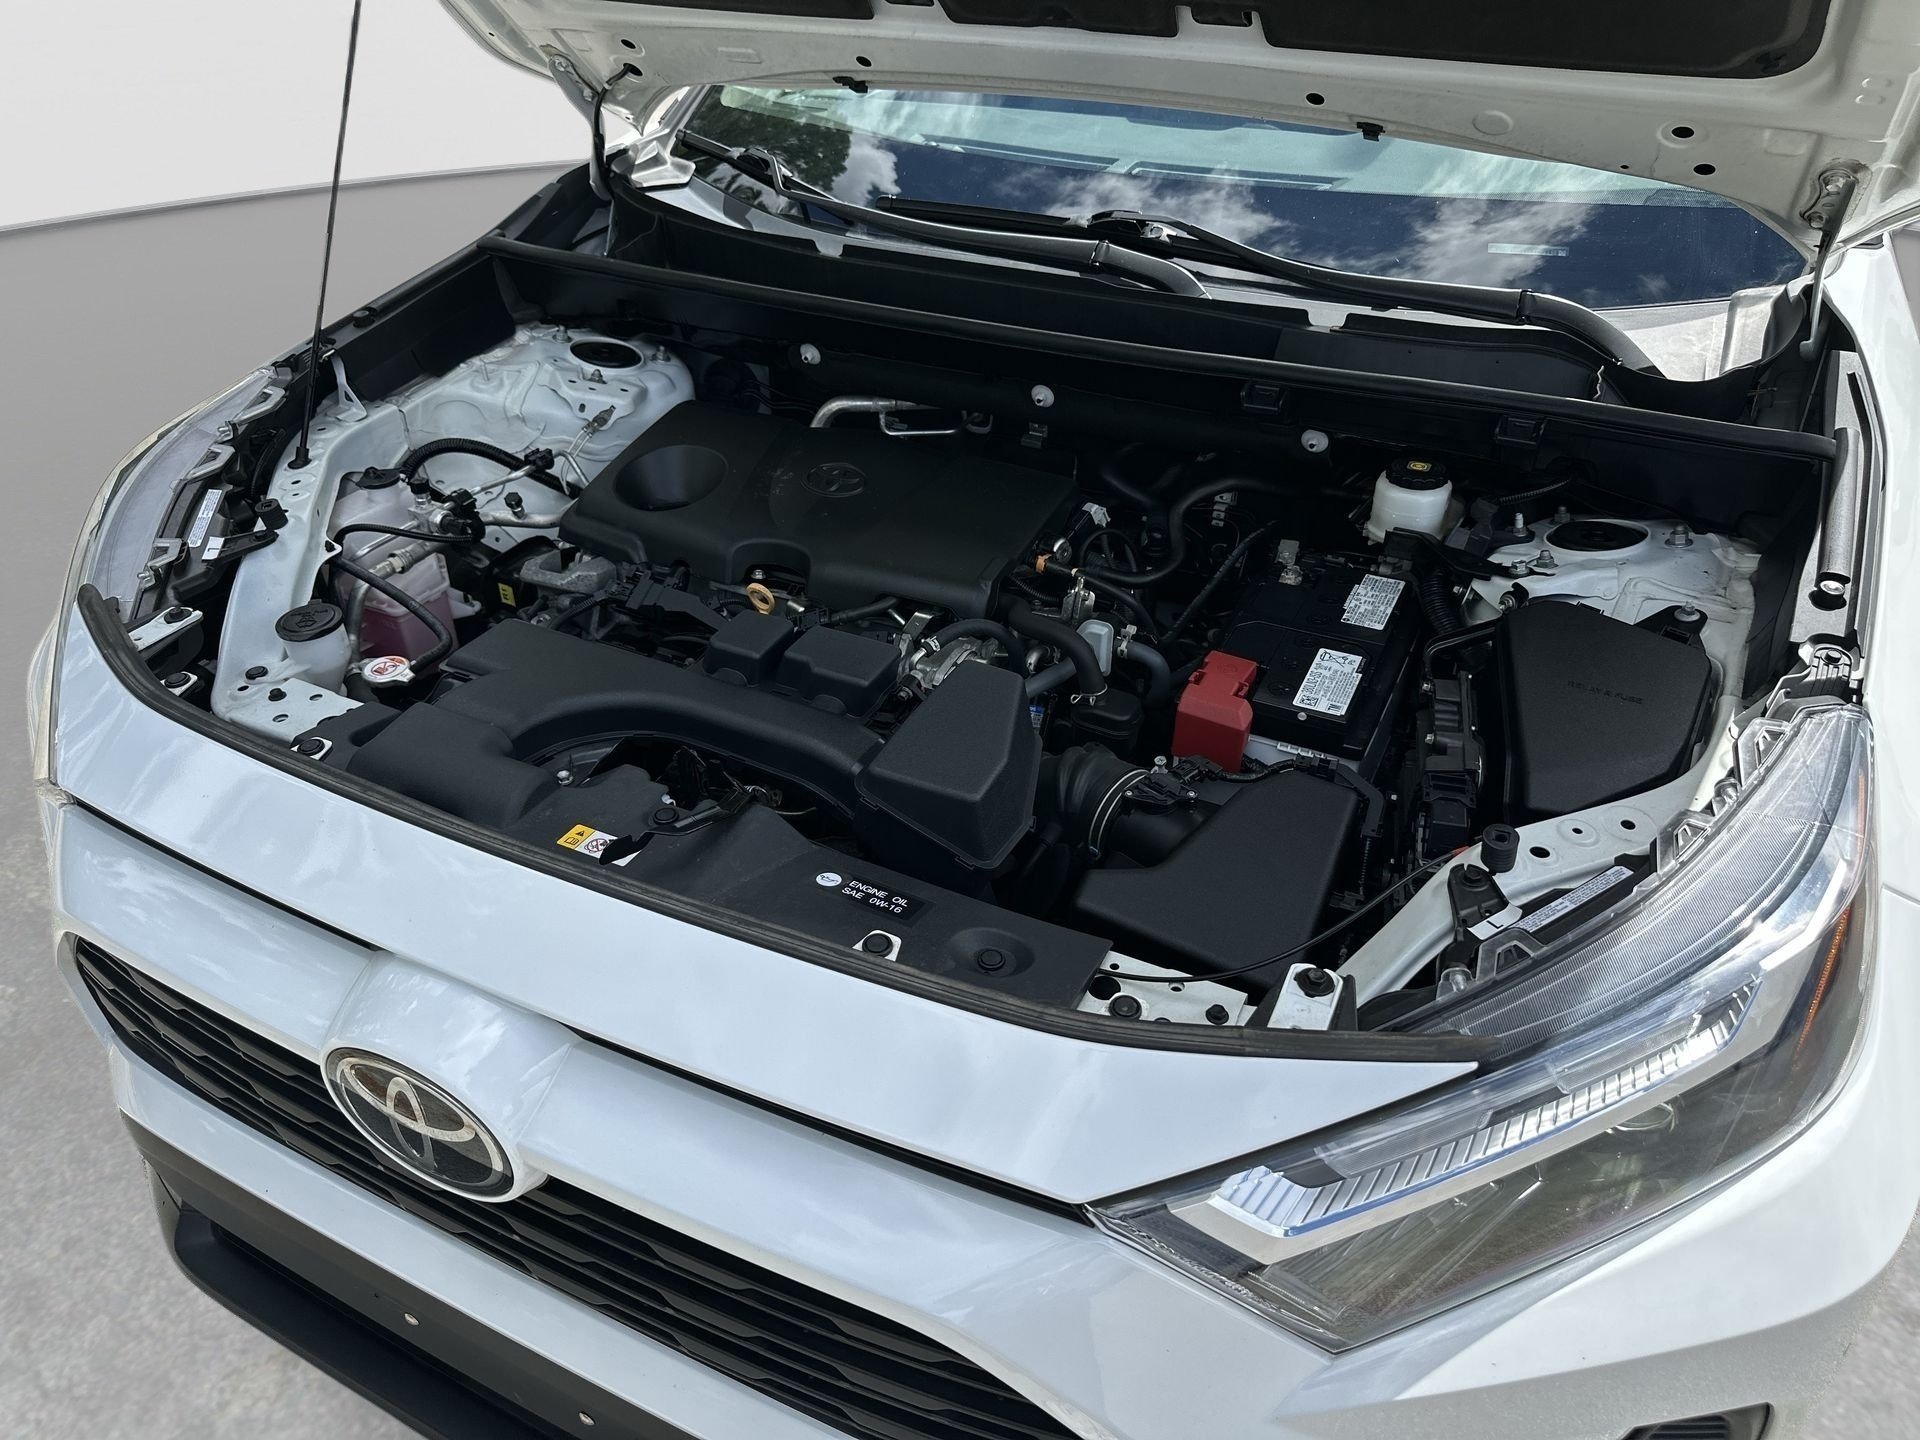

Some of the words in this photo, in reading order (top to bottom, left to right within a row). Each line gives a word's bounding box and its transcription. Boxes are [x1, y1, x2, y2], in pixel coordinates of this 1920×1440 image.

[841, 887, 866, 900] SAE
[869, 897, 903, 914] 0W-16
[849, 880, 889, 899] ENGINE
[892, 896, 908, 907] OIL
[1486, 920, 1504, 930] L
